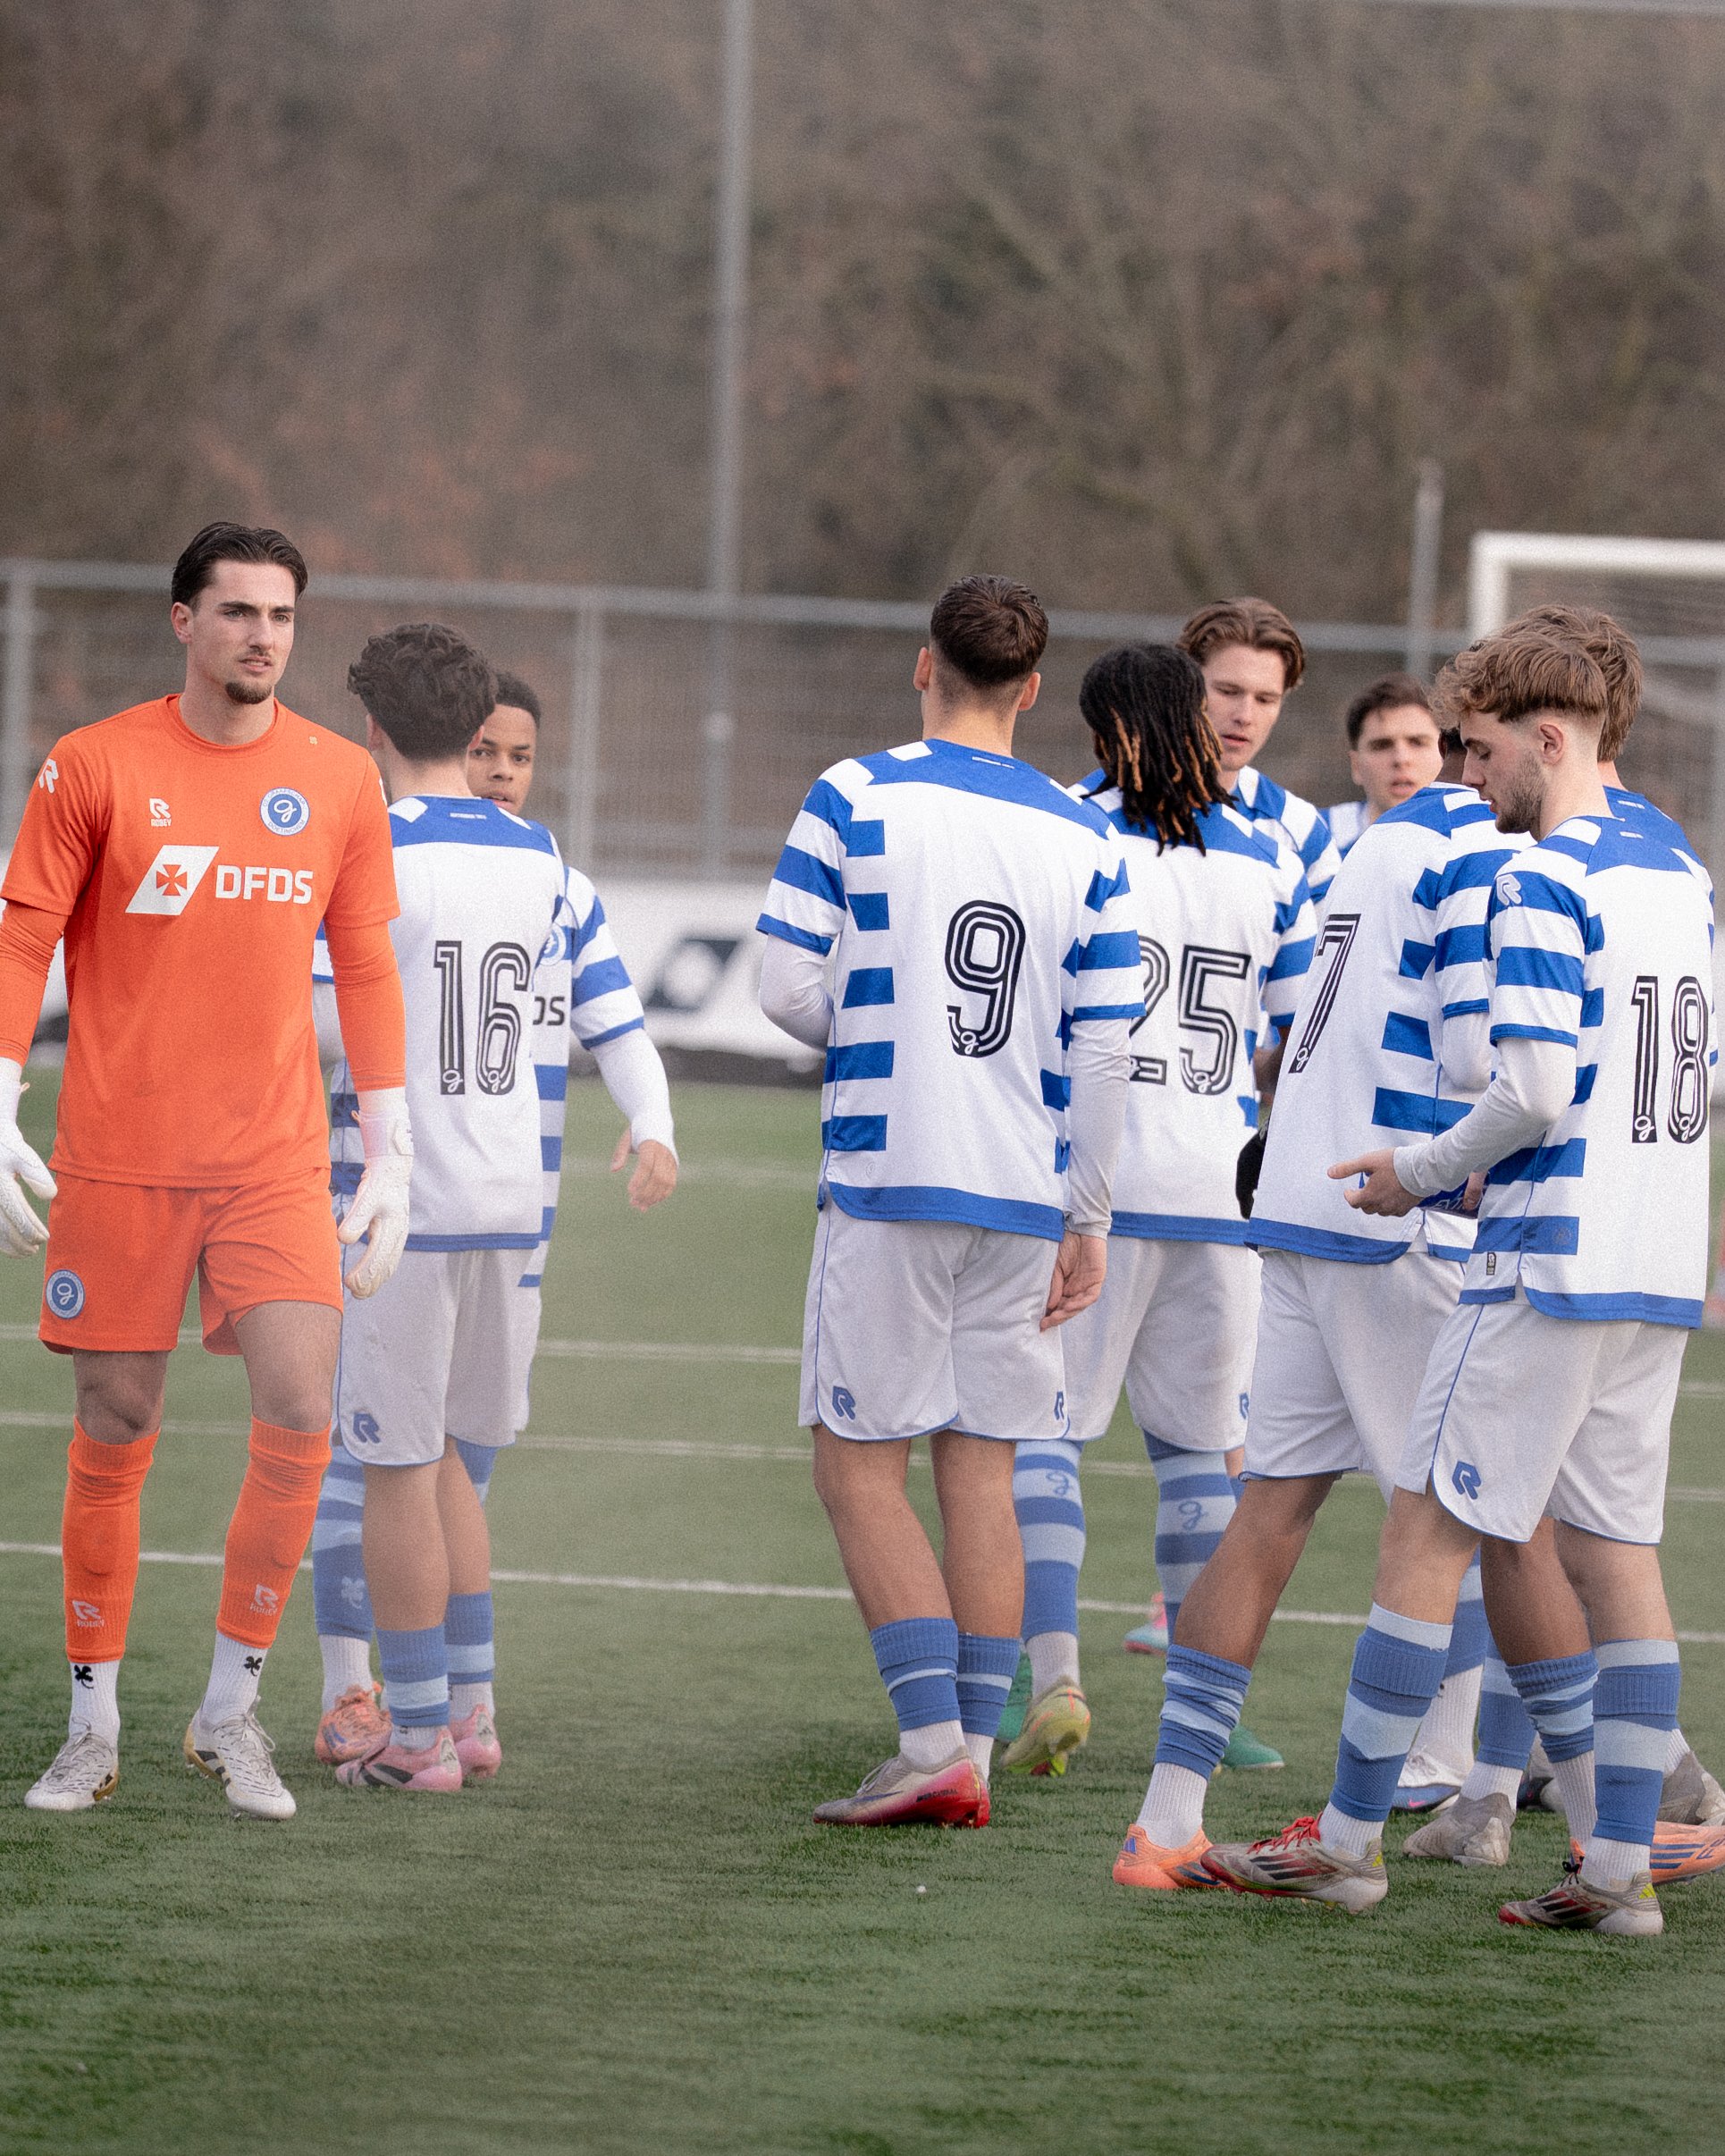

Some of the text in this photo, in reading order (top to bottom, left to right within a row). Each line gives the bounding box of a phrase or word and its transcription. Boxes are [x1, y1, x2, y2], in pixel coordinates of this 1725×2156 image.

[215, 865, 314, 904] DFDS
[433, 940, 531, 1096] 16
[944, 900, 1026, 1058] 9
[1129, 935, 1251, 1095] 25
[1288, 914, 1361, 1074] 7
[1631, 975, 1709, 1144] 18
